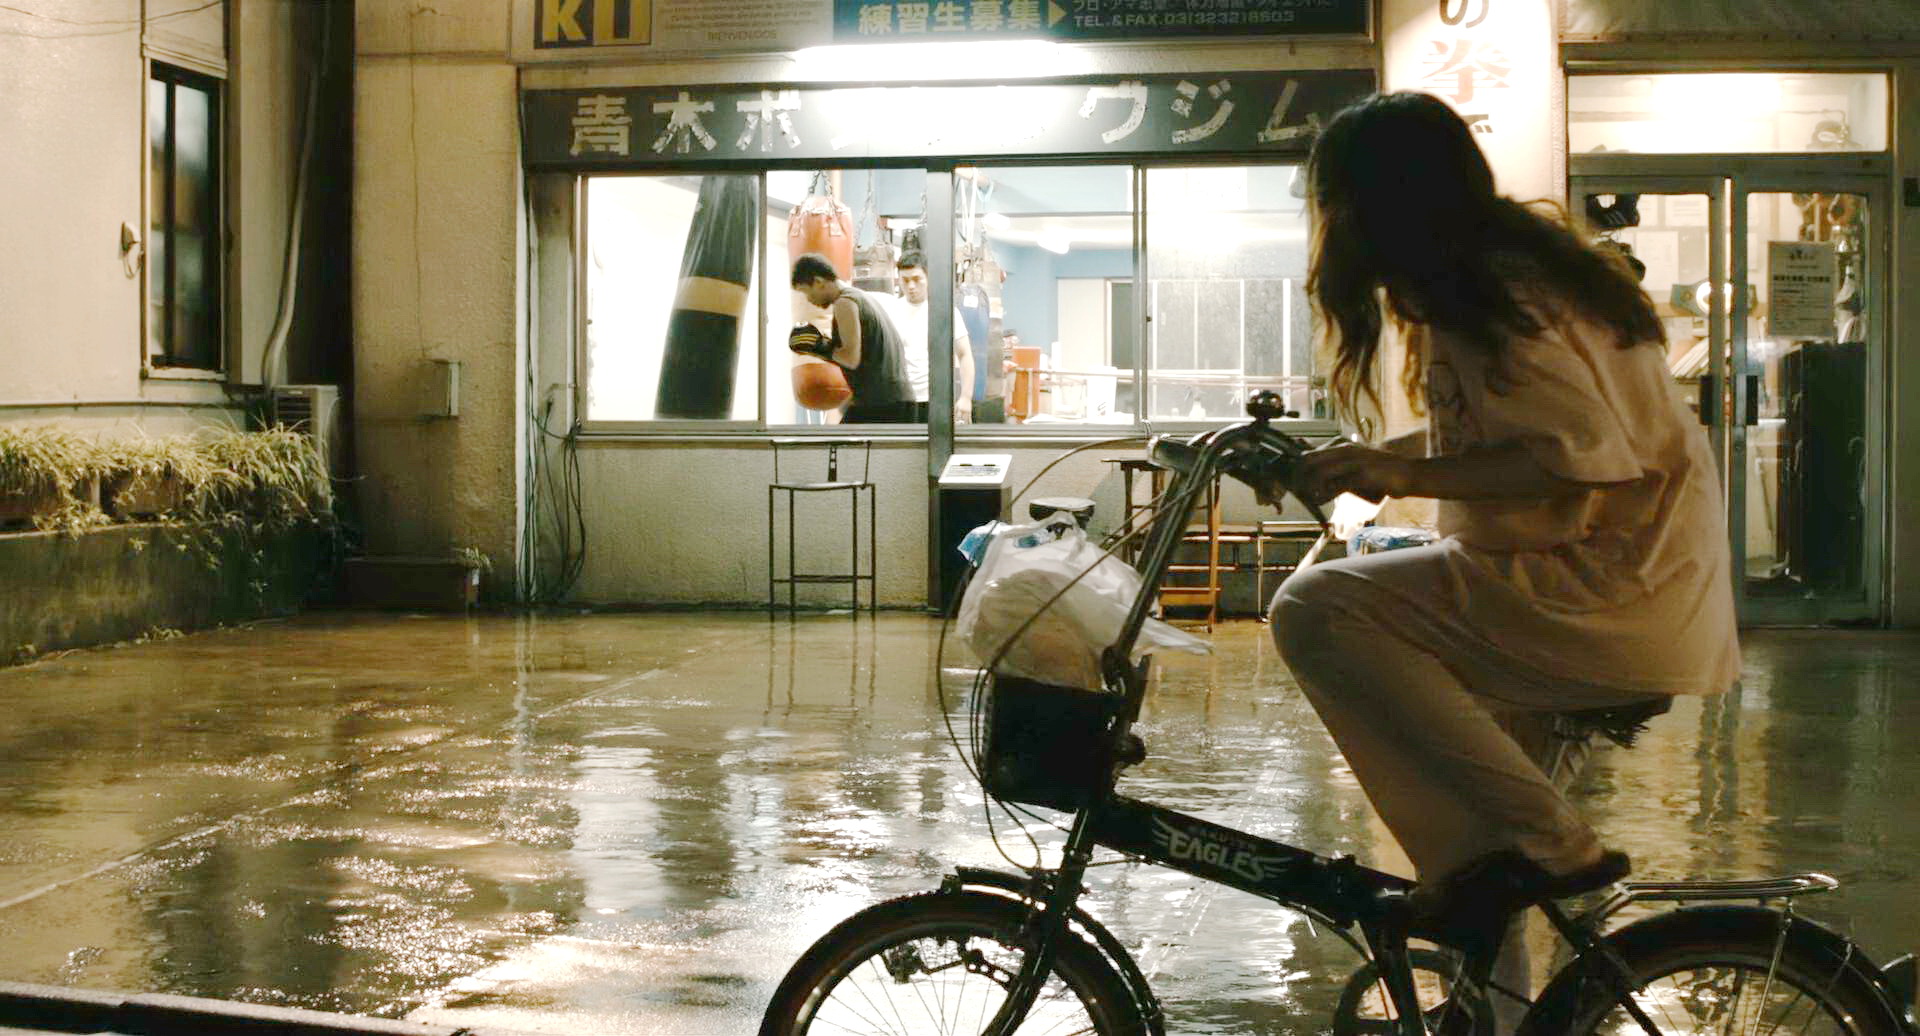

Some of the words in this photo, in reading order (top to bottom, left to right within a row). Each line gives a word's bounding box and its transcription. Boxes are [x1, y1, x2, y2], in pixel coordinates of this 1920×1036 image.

[858, 0, 1041, 35] 練習生募集
[1167, 831, 1265, 883] EAGLES
